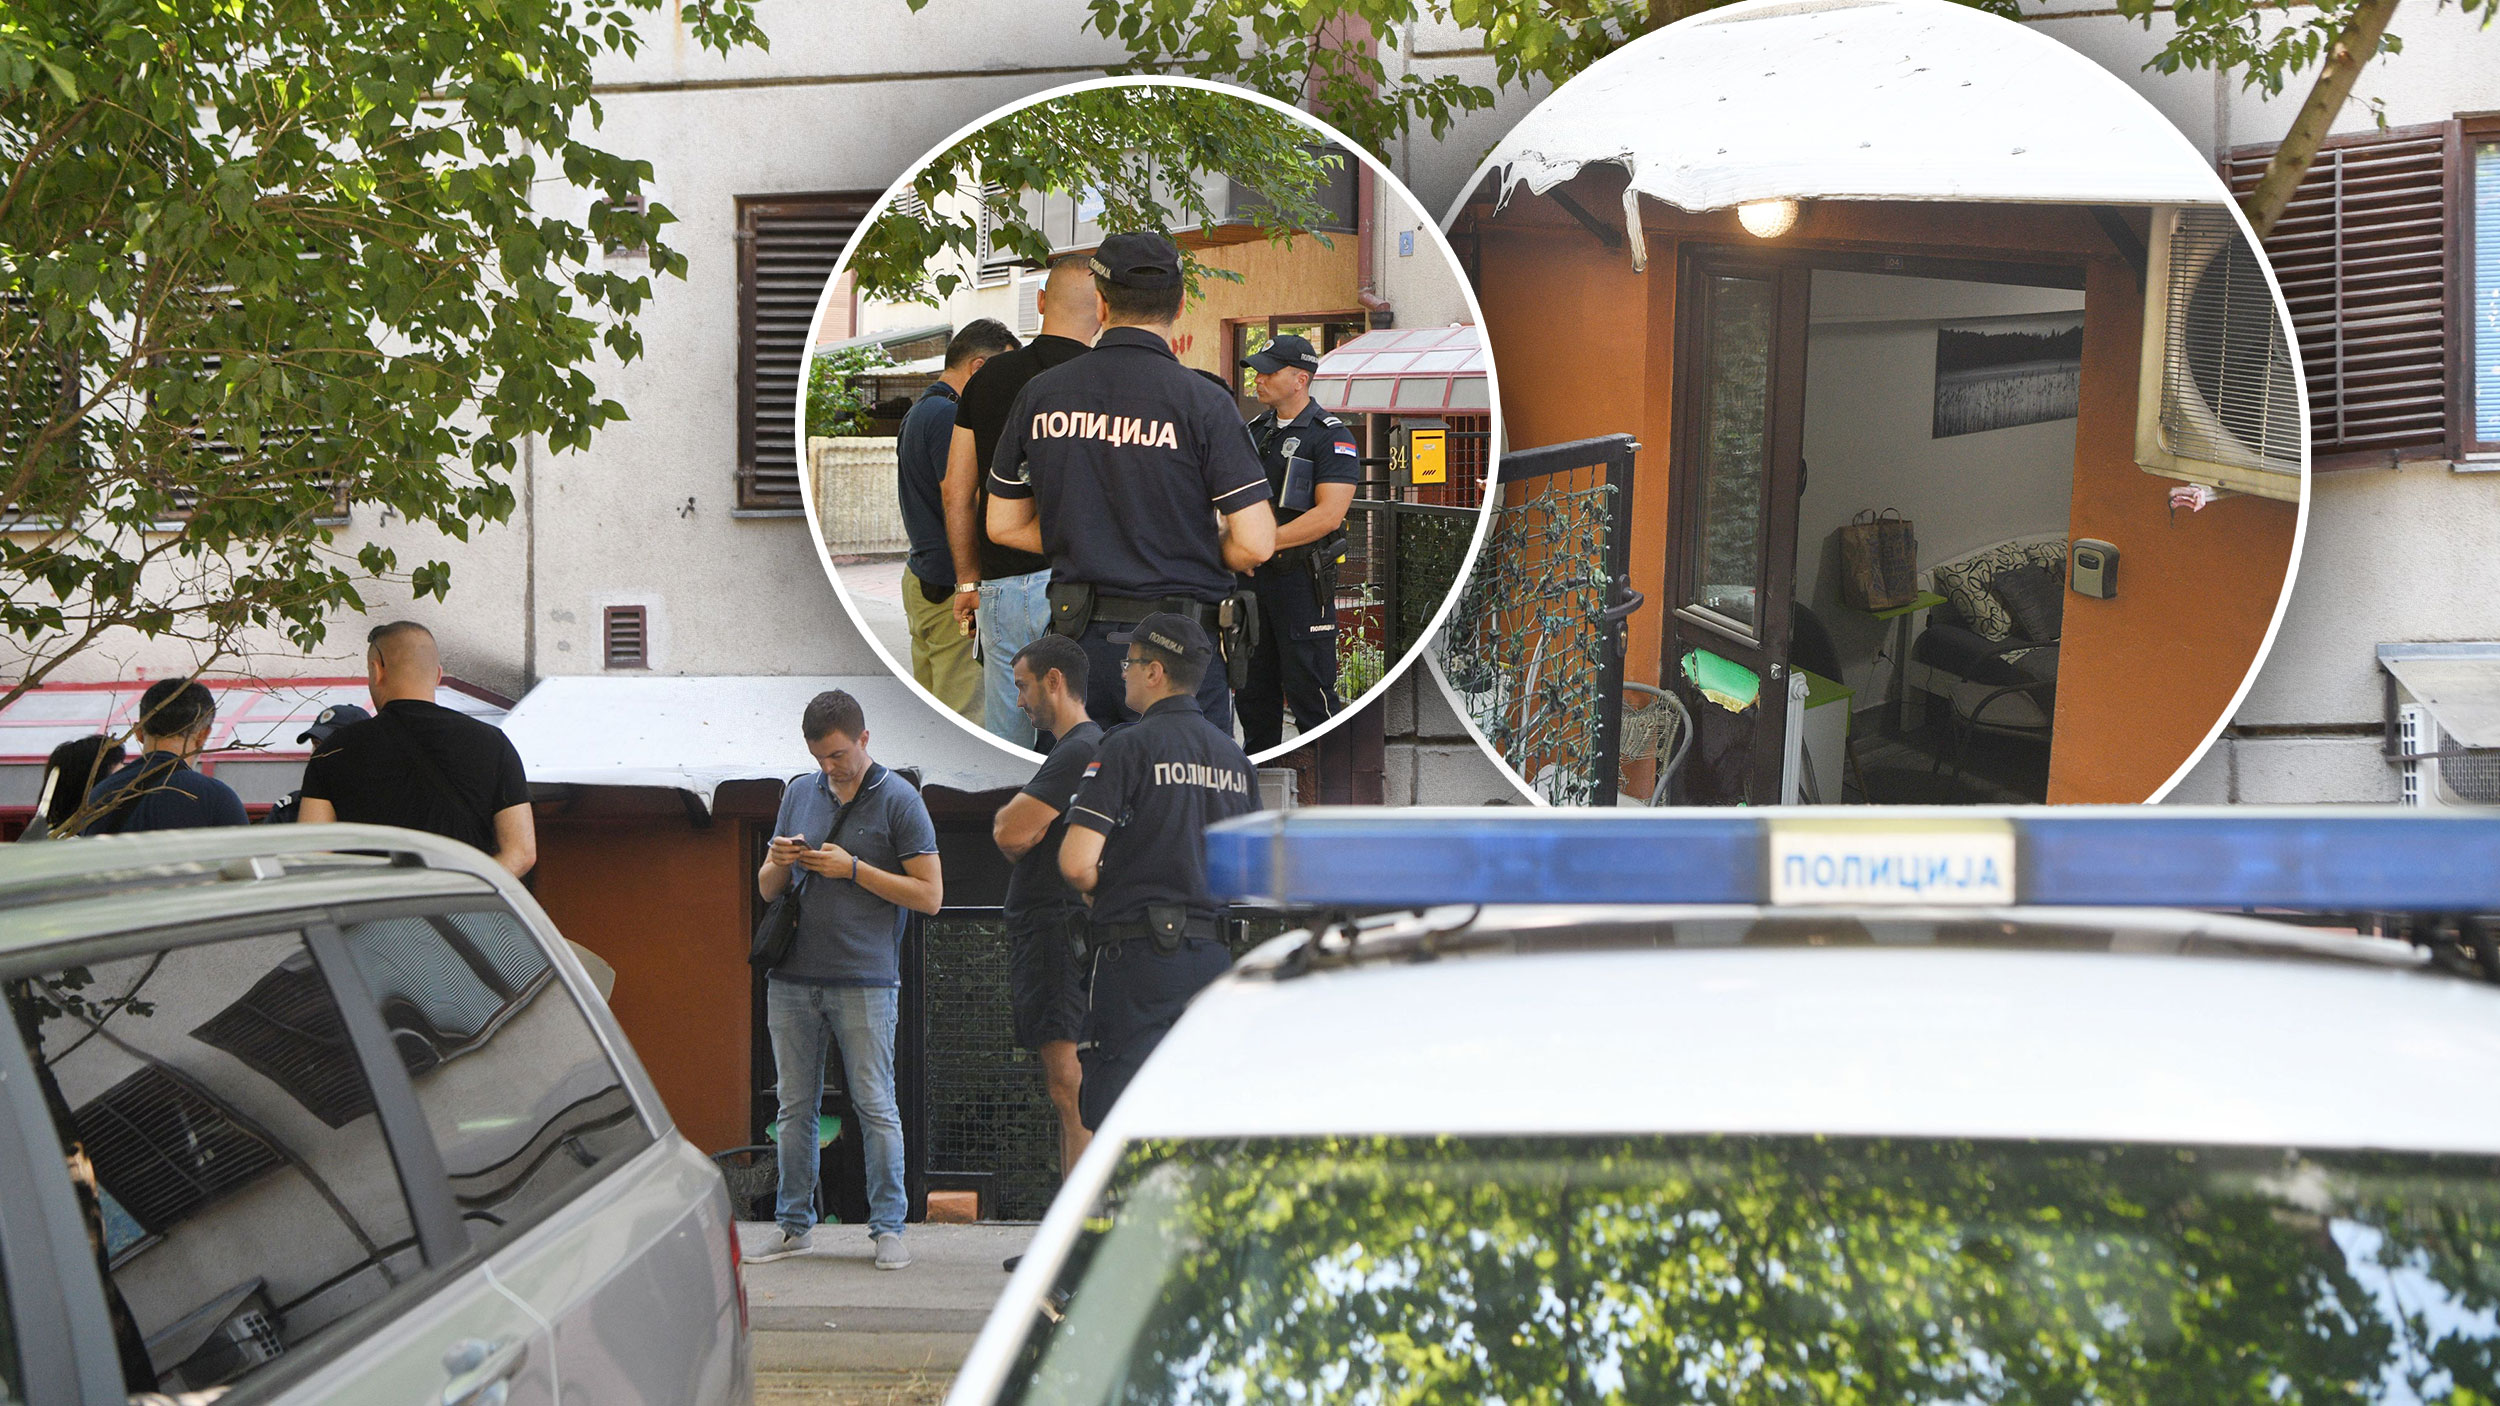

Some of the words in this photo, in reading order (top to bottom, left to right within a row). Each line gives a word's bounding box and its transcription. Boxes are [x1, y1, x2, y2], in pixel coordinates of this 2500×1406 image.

[1032, 411, 1178, 449] ПОЛИЦИЈА
[1389, 445, 1407, 470] 34
[1149, 632, 1184, 655] ПОЛИЦИЈА
[1154, 762, 1248, 796] ПОЛИЦИЈА
[1784, 854, 2000, 891] ПОЛИЦИЈА
